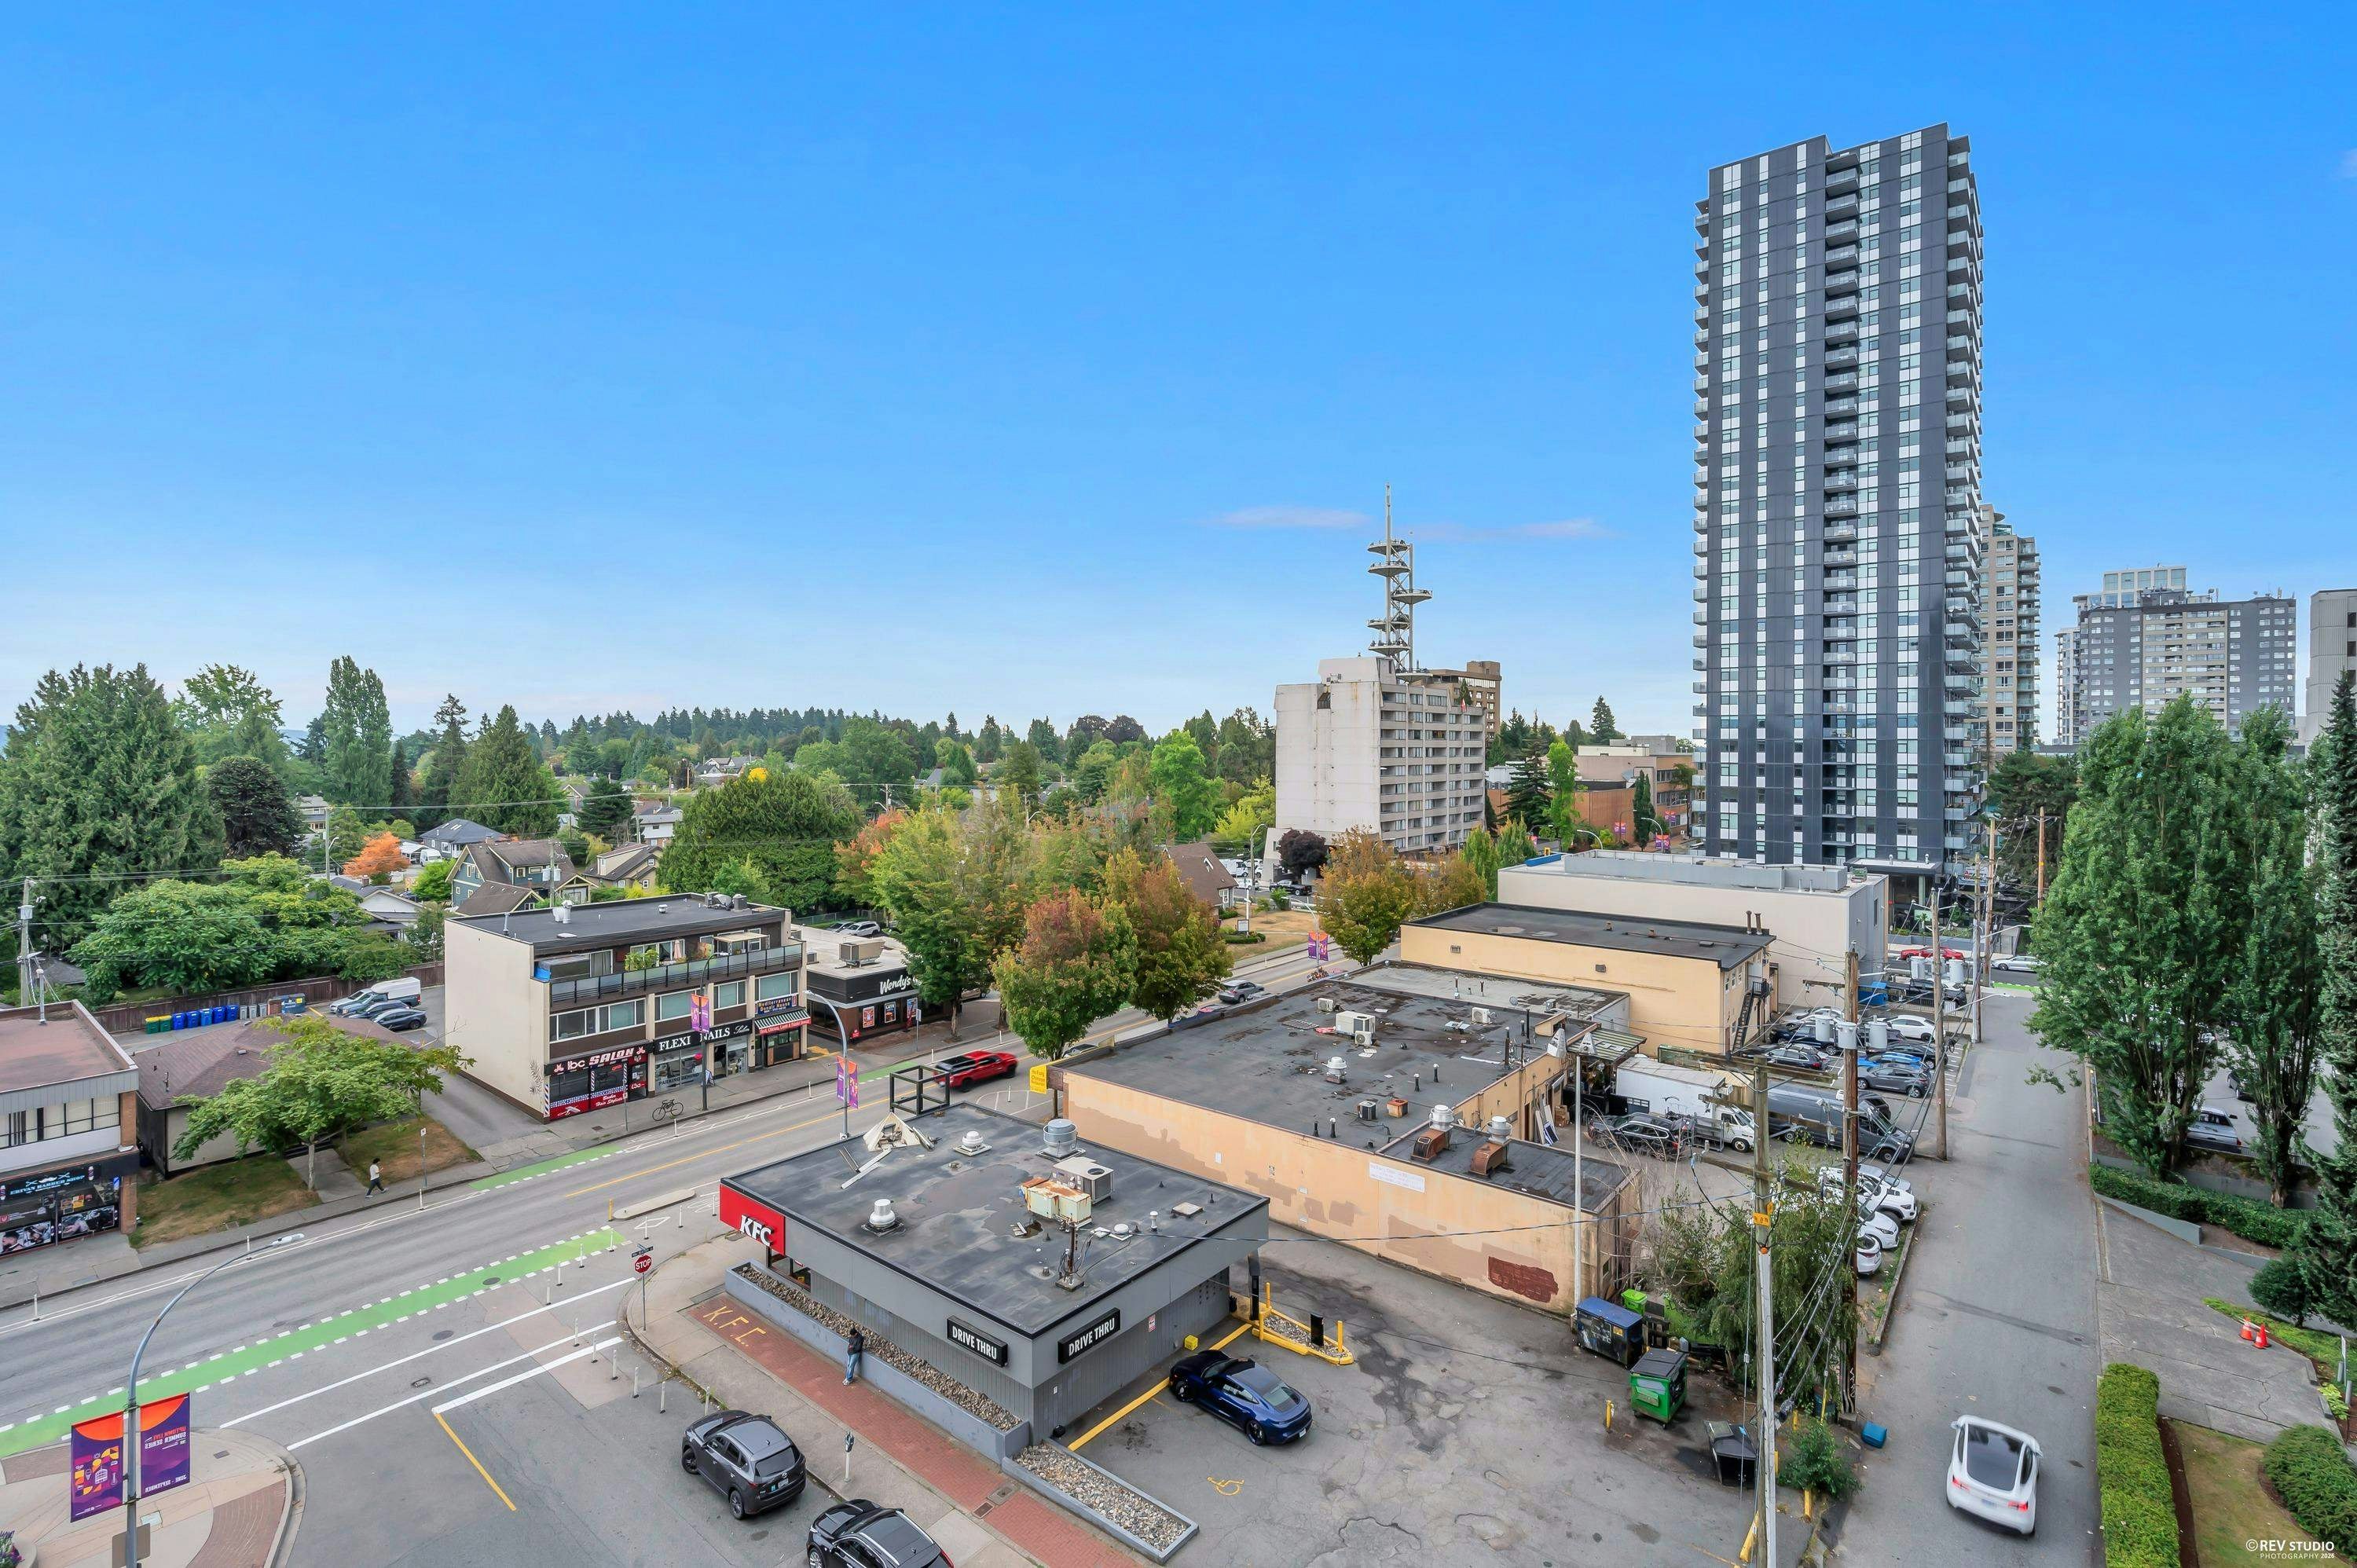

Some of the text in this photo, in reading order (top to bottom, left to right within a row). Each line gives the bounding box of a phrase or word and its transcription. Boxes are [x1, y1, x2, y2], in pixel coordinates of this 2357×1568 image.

[880, 975, 911, 995] Wendy's
[659, 1036, 691, 1051] FLEXI
[700, 1028, 730, 1042] NAILS
[589, 1048, 634, 1066] SALON
[739, 1214, 772, 1247] KFC
[636, 1258, 651, 1270] STOP
[952, 1325, 997, 1360] DRIVE THRU
[1069, 1317, 1115, 1357] DRIVE THRU
